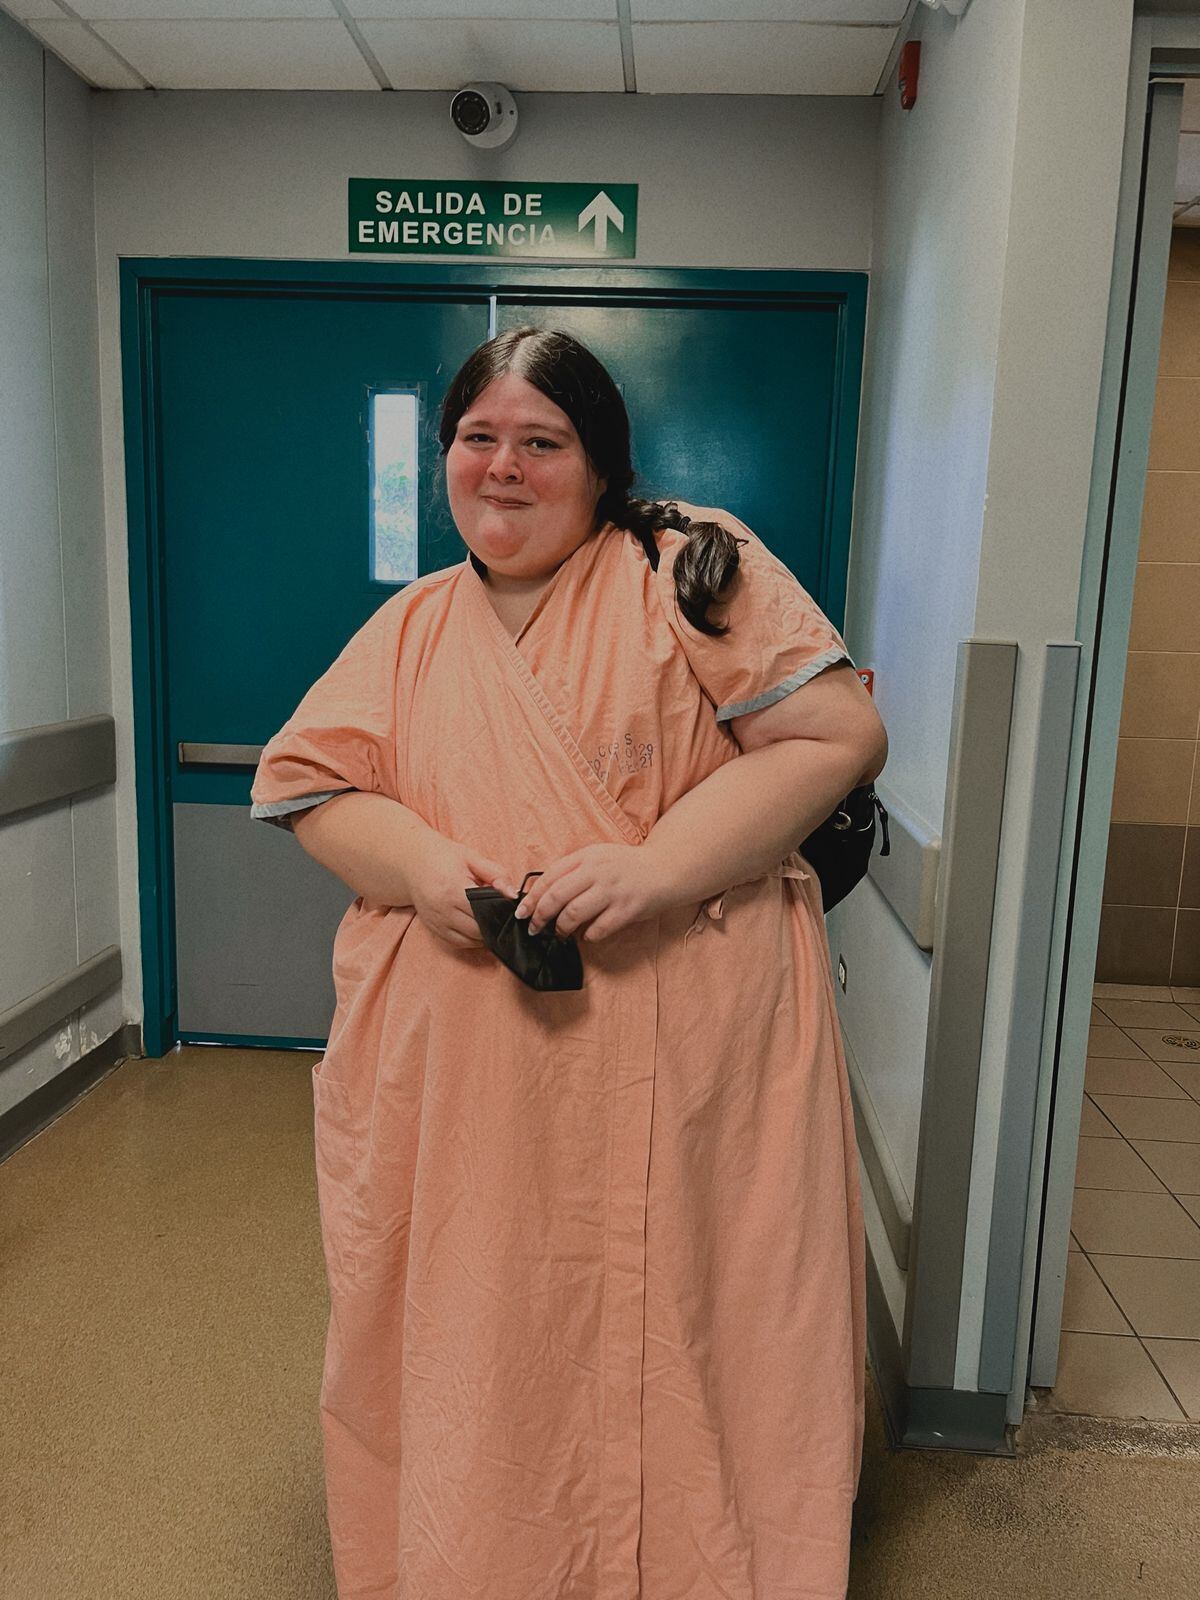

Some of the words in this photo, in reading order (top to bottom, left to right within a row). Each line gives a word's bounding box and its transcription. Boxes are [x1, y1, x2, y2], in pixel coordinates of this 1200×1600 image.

[375, 191, 486, 214] SALIDA
[503, 193, 542, 216] DE
[358, 220, 556, 245] EMERGENCIA
